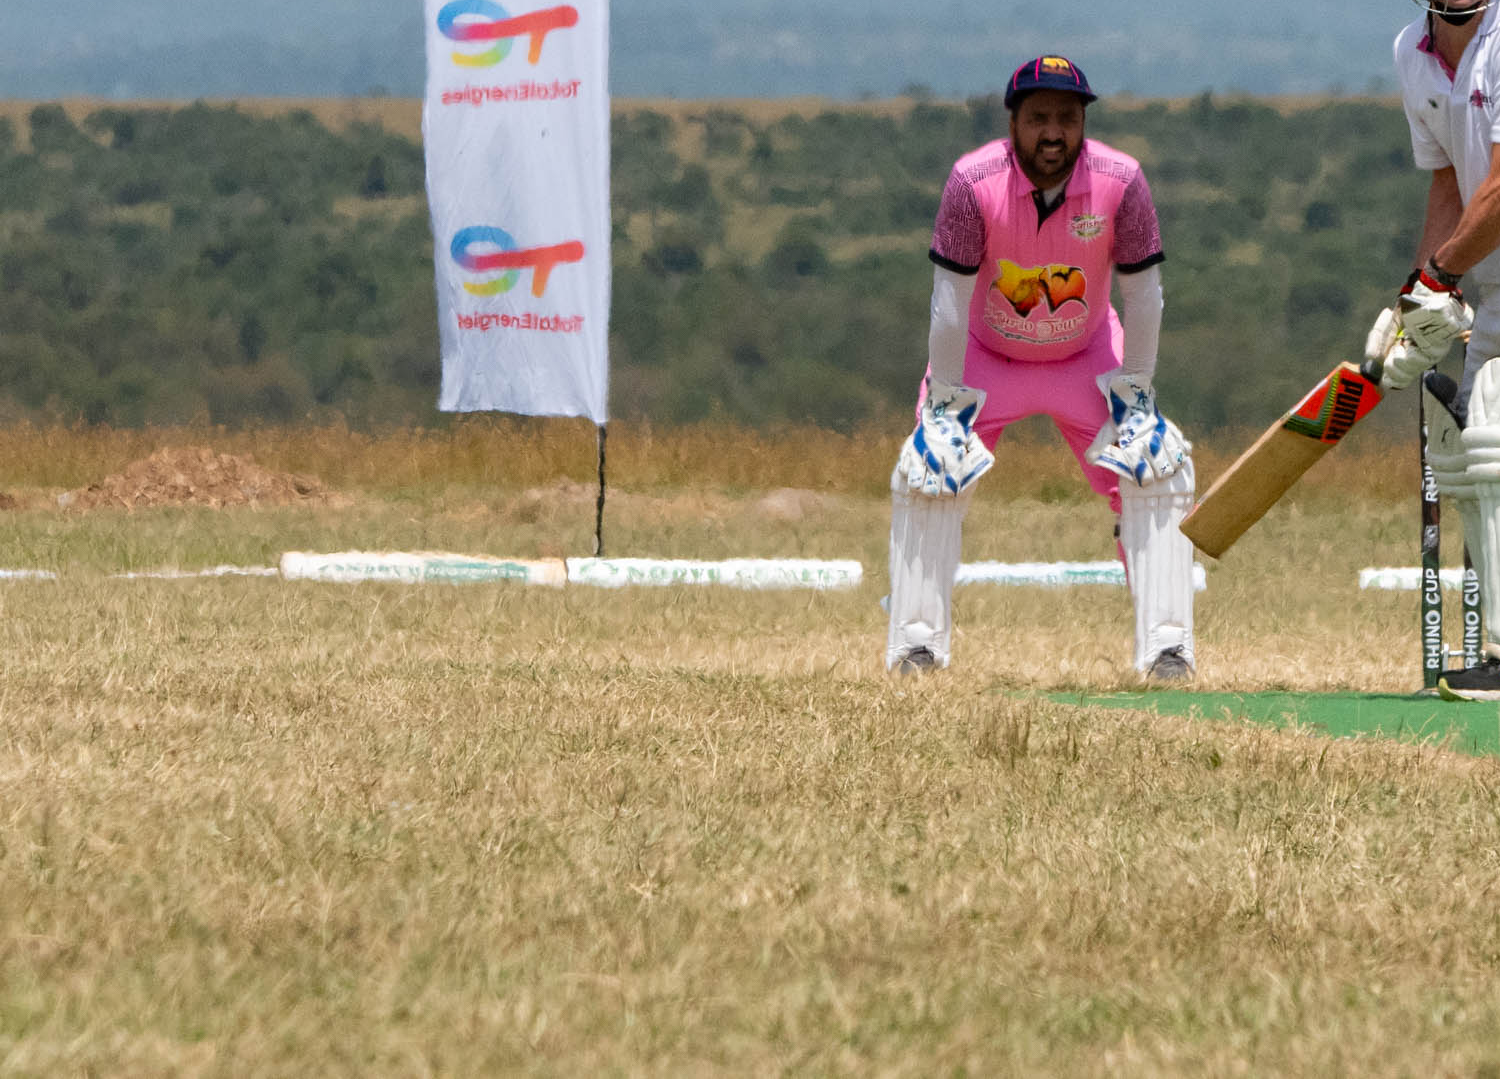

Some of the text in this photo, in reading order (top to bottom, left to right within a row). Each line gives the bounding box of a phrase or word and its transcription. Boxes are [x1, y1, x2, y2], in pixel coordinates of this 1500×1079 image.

[1425, 568, 1440, 669] RHINO CUP
[1463, 569, 1480, 669] RHINO CUP
